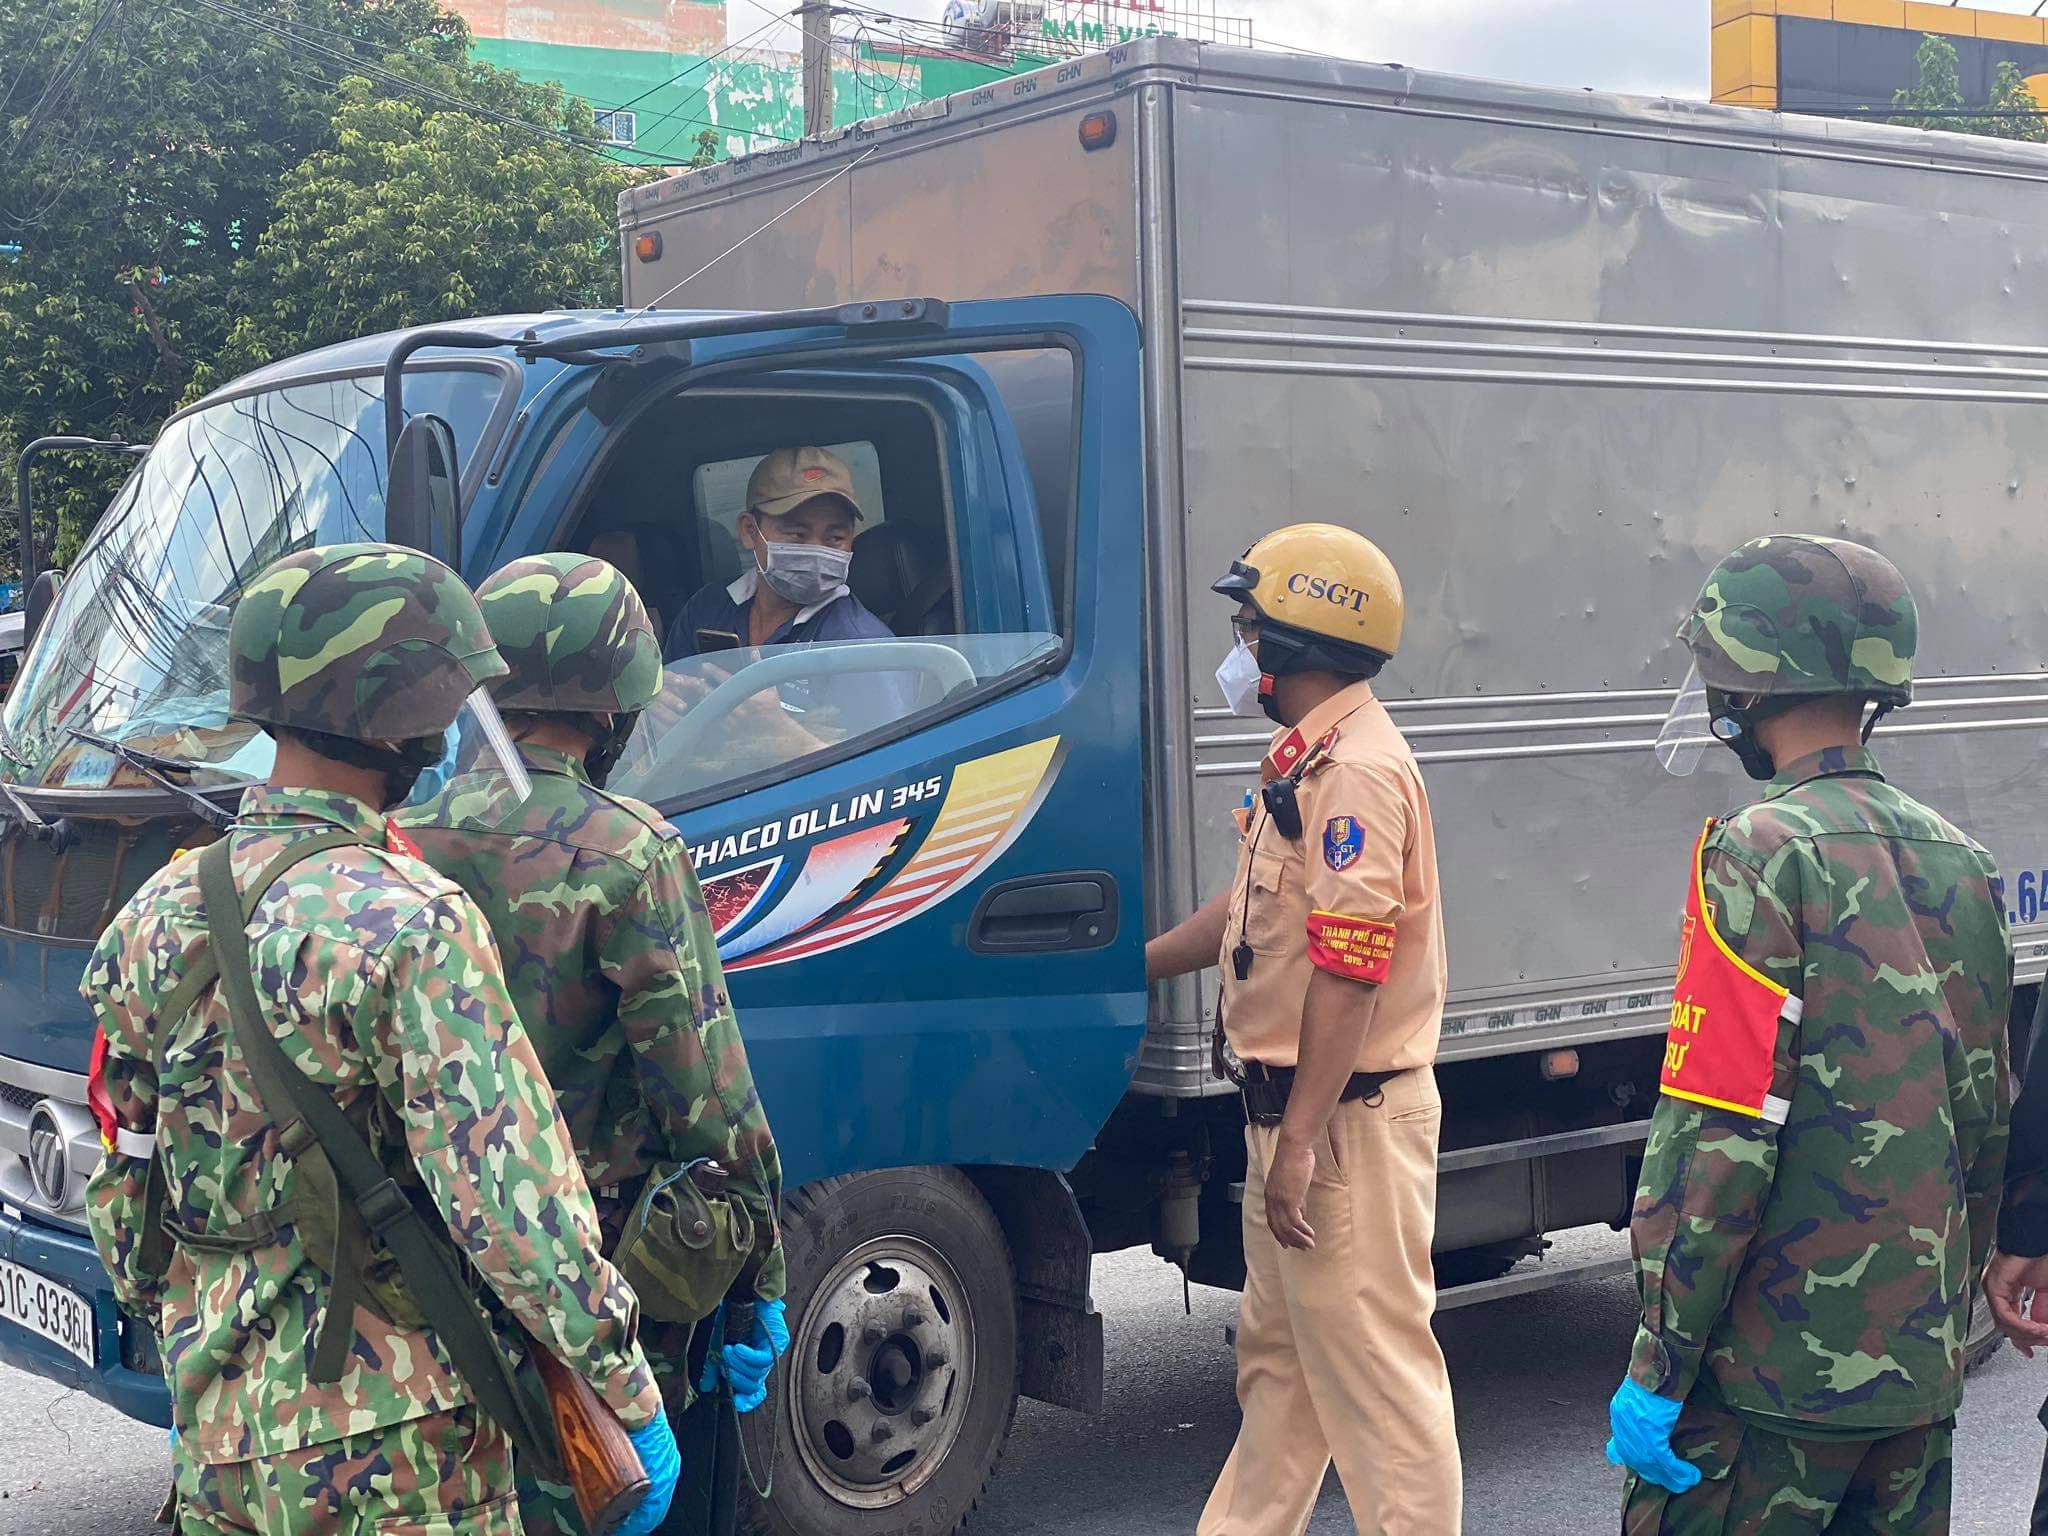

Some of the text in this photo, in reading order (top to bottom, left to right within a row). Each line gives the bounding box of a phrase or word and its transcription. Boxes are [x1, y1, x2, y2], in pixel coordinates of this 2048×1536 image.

[1042, 18, 1178, 42] NAM VI
[971, 89, 994, 106] GHN
[1013, 77, 1037, 96] GHN
[1057, 63, 1082, 83] GHN
[1287, 573, 1370, 612] CSGT
[787, 788, 885, 841] OLLIN
[890, 776, 942, 809] 345
[1441, 993, 1653, 1035] GHN GHN GHN GHN GHN
[1670, 994, 1707, 1034] OÁT
